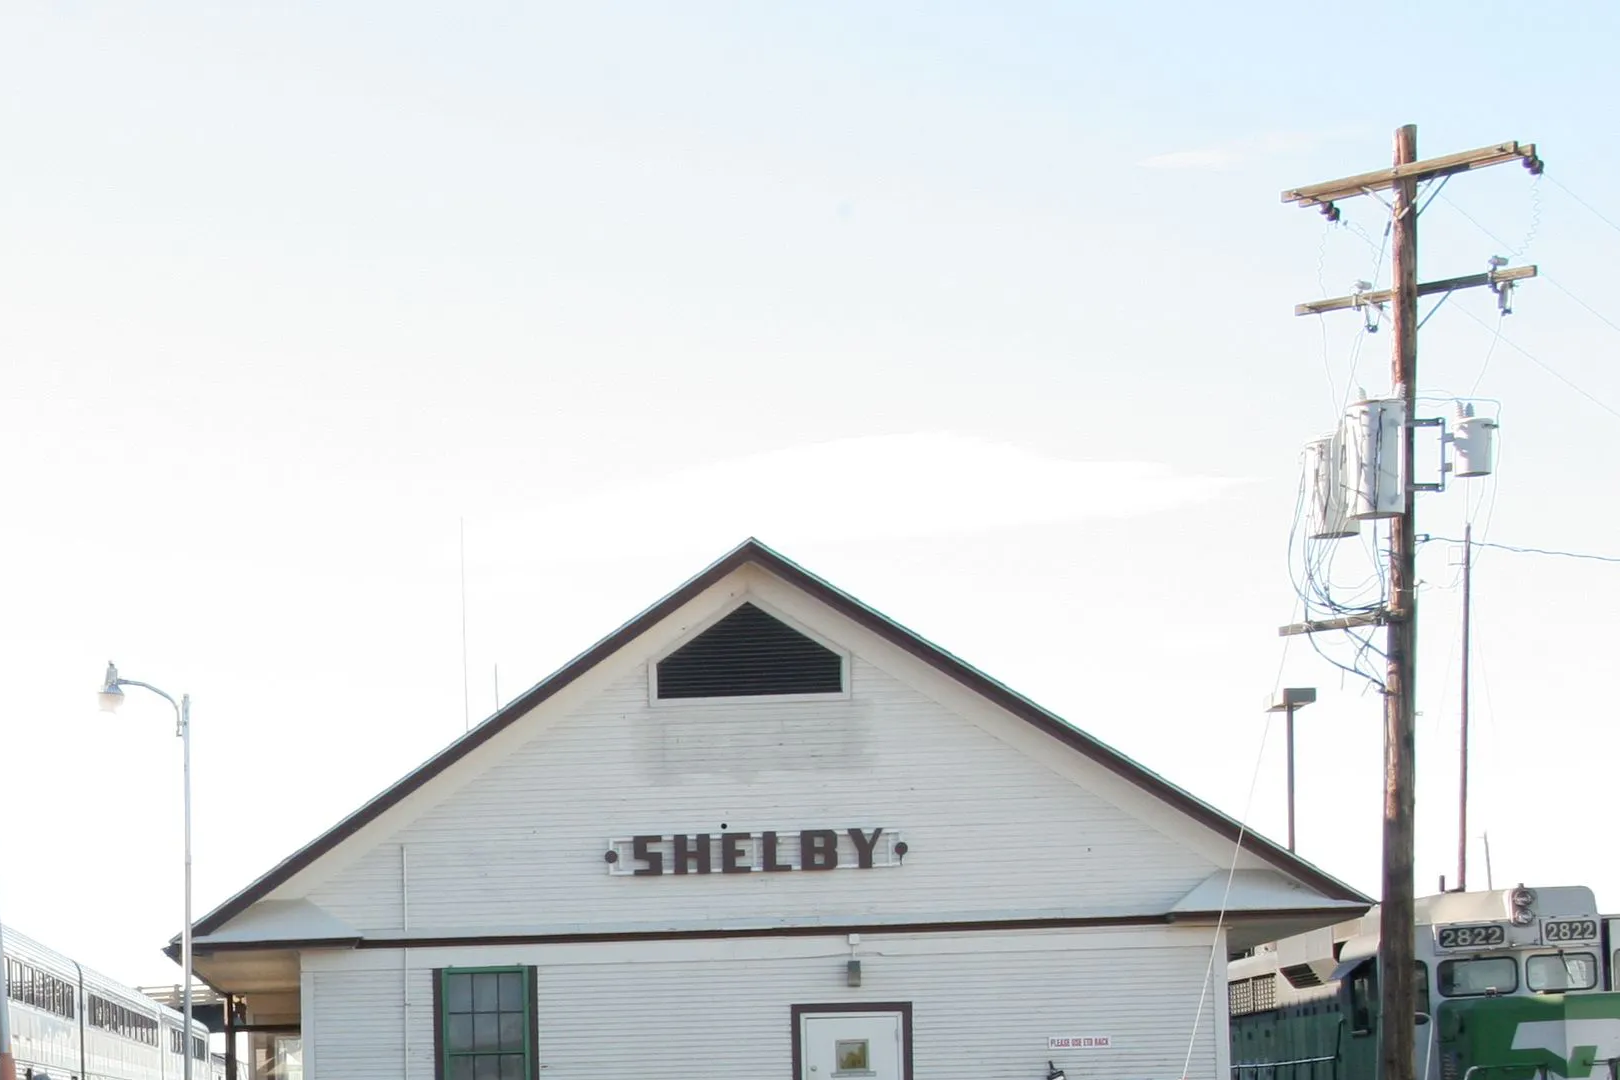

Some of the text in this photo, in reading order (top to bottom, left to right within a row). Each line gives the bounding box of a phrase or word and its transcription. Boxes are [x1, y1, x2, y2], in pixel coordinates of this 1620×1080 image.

[632, 828, 884, 876] SHELBY
[1442, 928, 1502, 947] 2822
[1547, 922, 1594, 940] 2822
[1050, 1038, 1070, 1048] PLEASE
